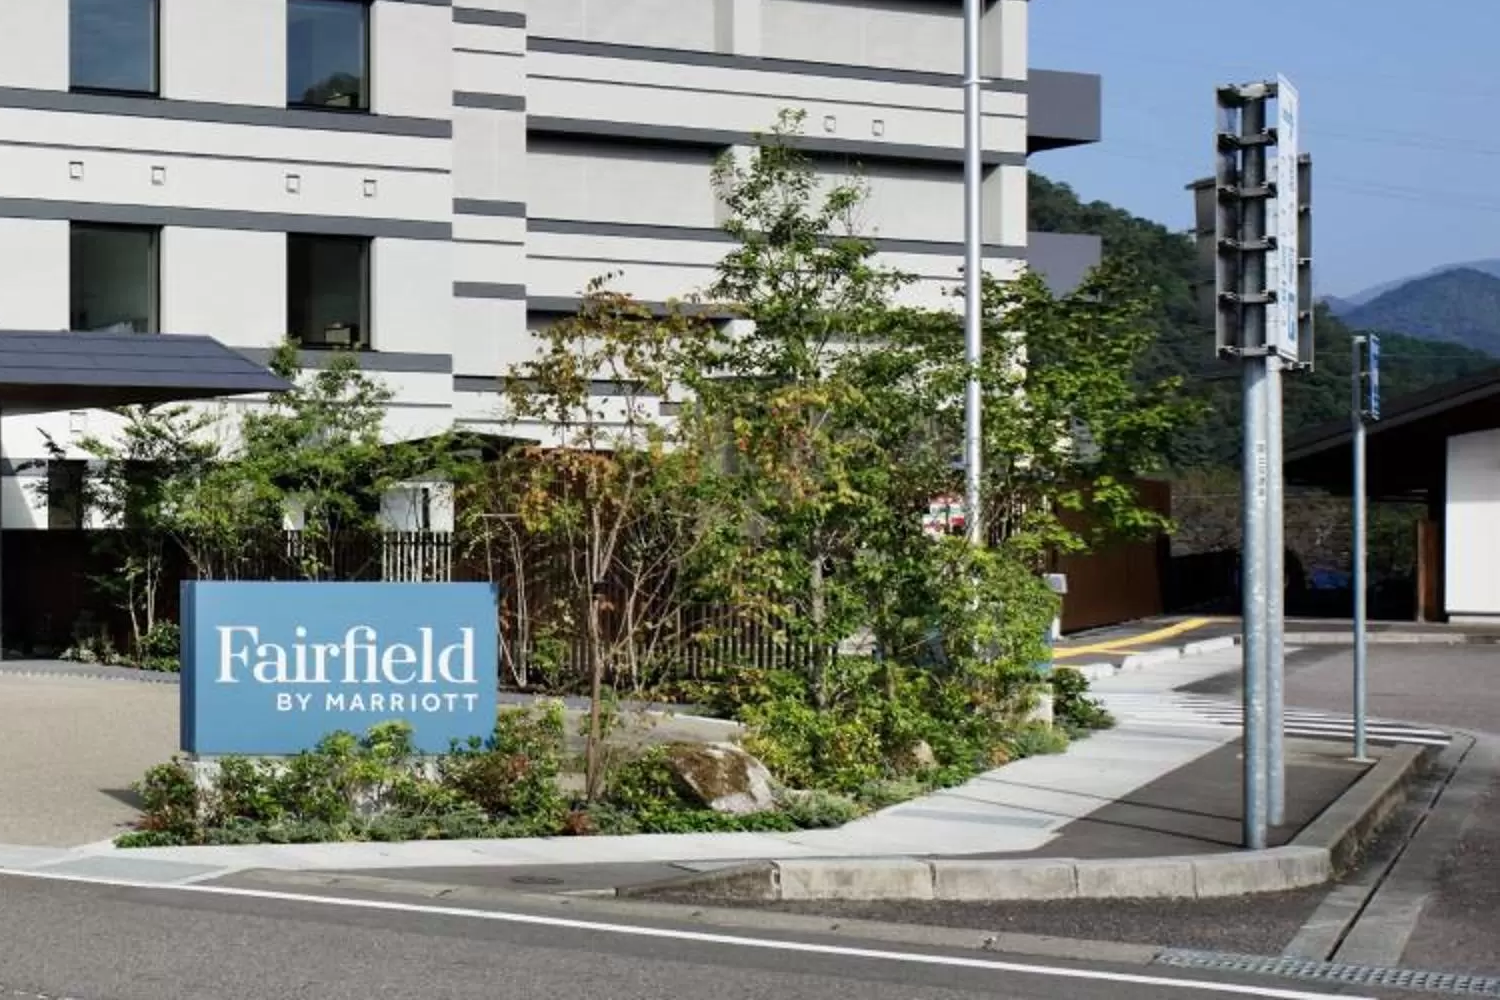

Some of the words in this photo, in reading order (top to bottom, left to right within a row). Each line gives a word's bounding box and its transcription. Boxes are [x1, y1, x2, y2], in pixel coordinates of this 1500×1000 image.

[215, 624, 478, 684] Fairfield
[276, 693, 313, 712] BY
[325, 693, 479, 712] MARRIOTT
